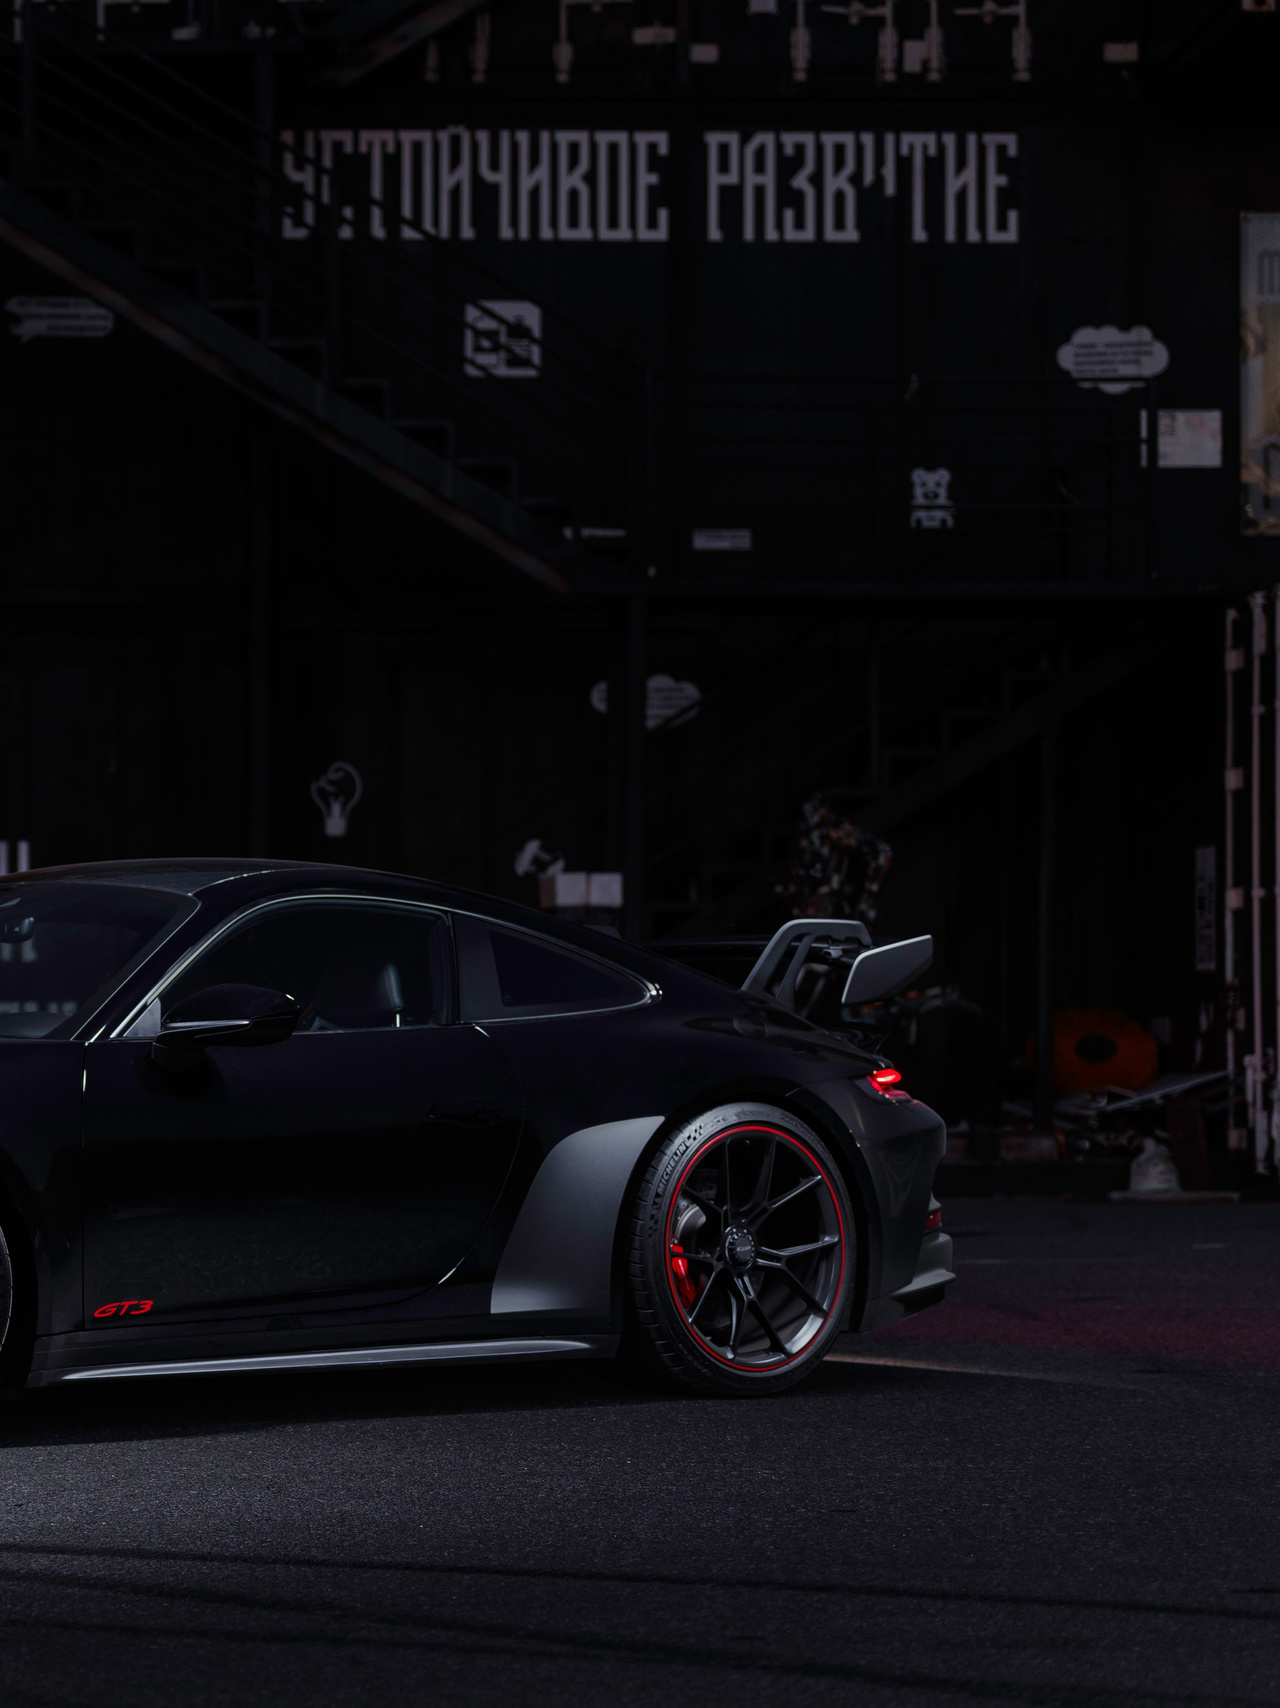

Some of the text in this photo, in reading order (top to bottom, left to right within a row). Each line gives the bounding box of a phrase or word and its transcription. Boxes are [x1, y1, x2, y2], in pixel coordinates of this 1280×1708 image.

[279, 124, 670, 242] УСТОЙЧИВОЕ
[657, 1142, 689, 1195] MICHELIN
[93, 1299, 154, 1318] GT3
